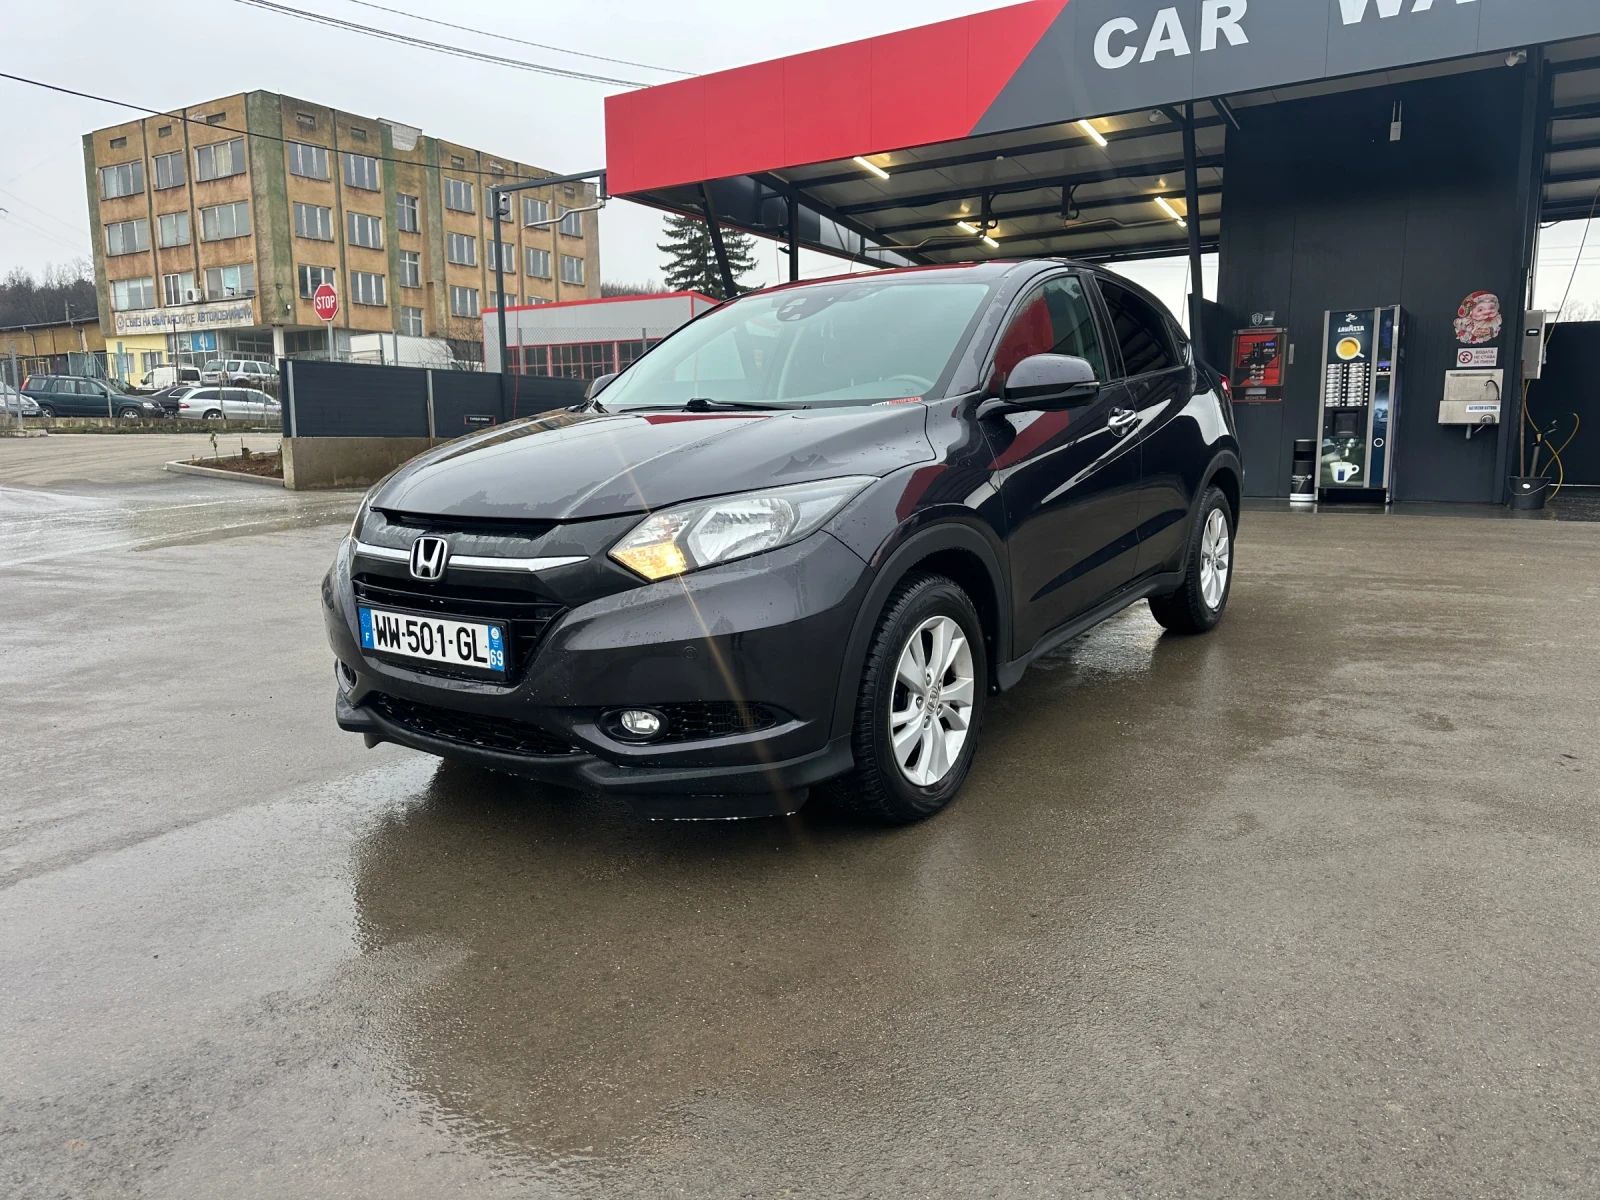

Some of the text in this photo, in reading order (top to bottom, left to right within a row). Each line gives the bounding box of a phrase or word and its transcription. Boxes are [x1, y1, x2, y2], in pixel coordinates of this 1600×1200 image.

[1093, 0, 1249, 70] CAR
[316, 295, 335, 310] STOP
[143, 314, 152, 327] НА
[365, 632, 370, 642] F
[490, 649, 504, 667] 69
